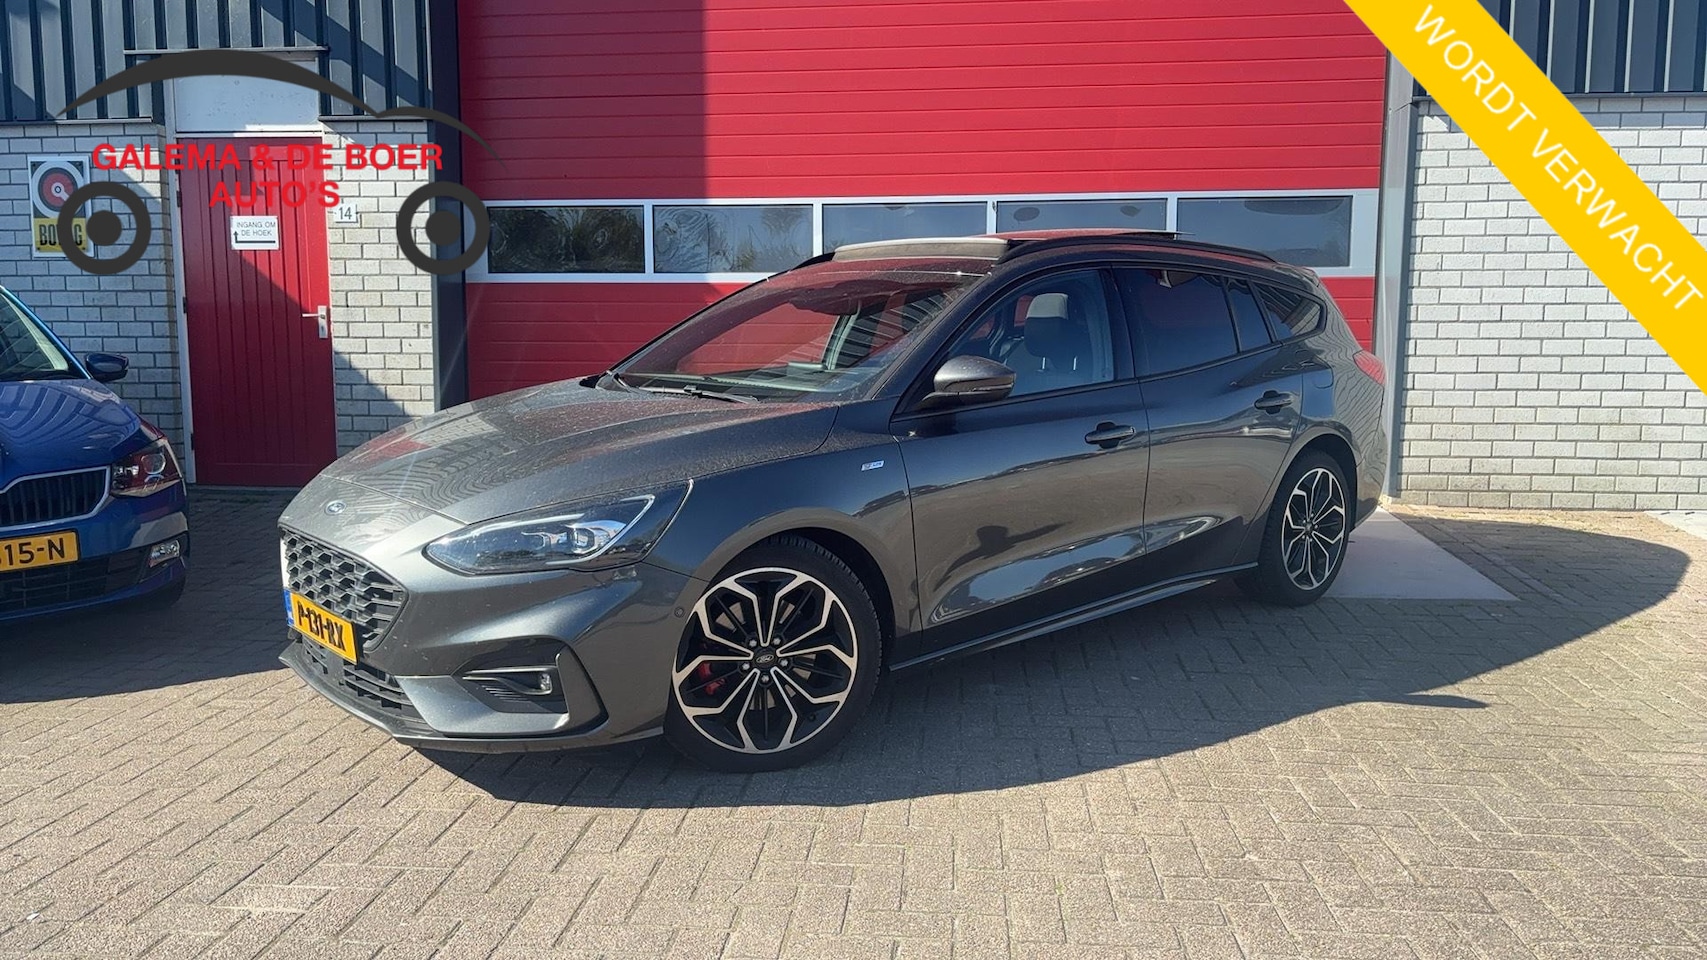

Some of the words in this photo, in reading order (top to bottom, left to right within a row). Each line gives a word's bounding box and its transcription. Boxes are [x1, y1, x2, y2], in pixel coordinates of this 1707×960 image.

[339, 206, 352, 220] 14
[39, 223, 83, 246] BOG
[0, 537, 65, 566] 15-N
[298, 600, 346, 652] P-131-RX
